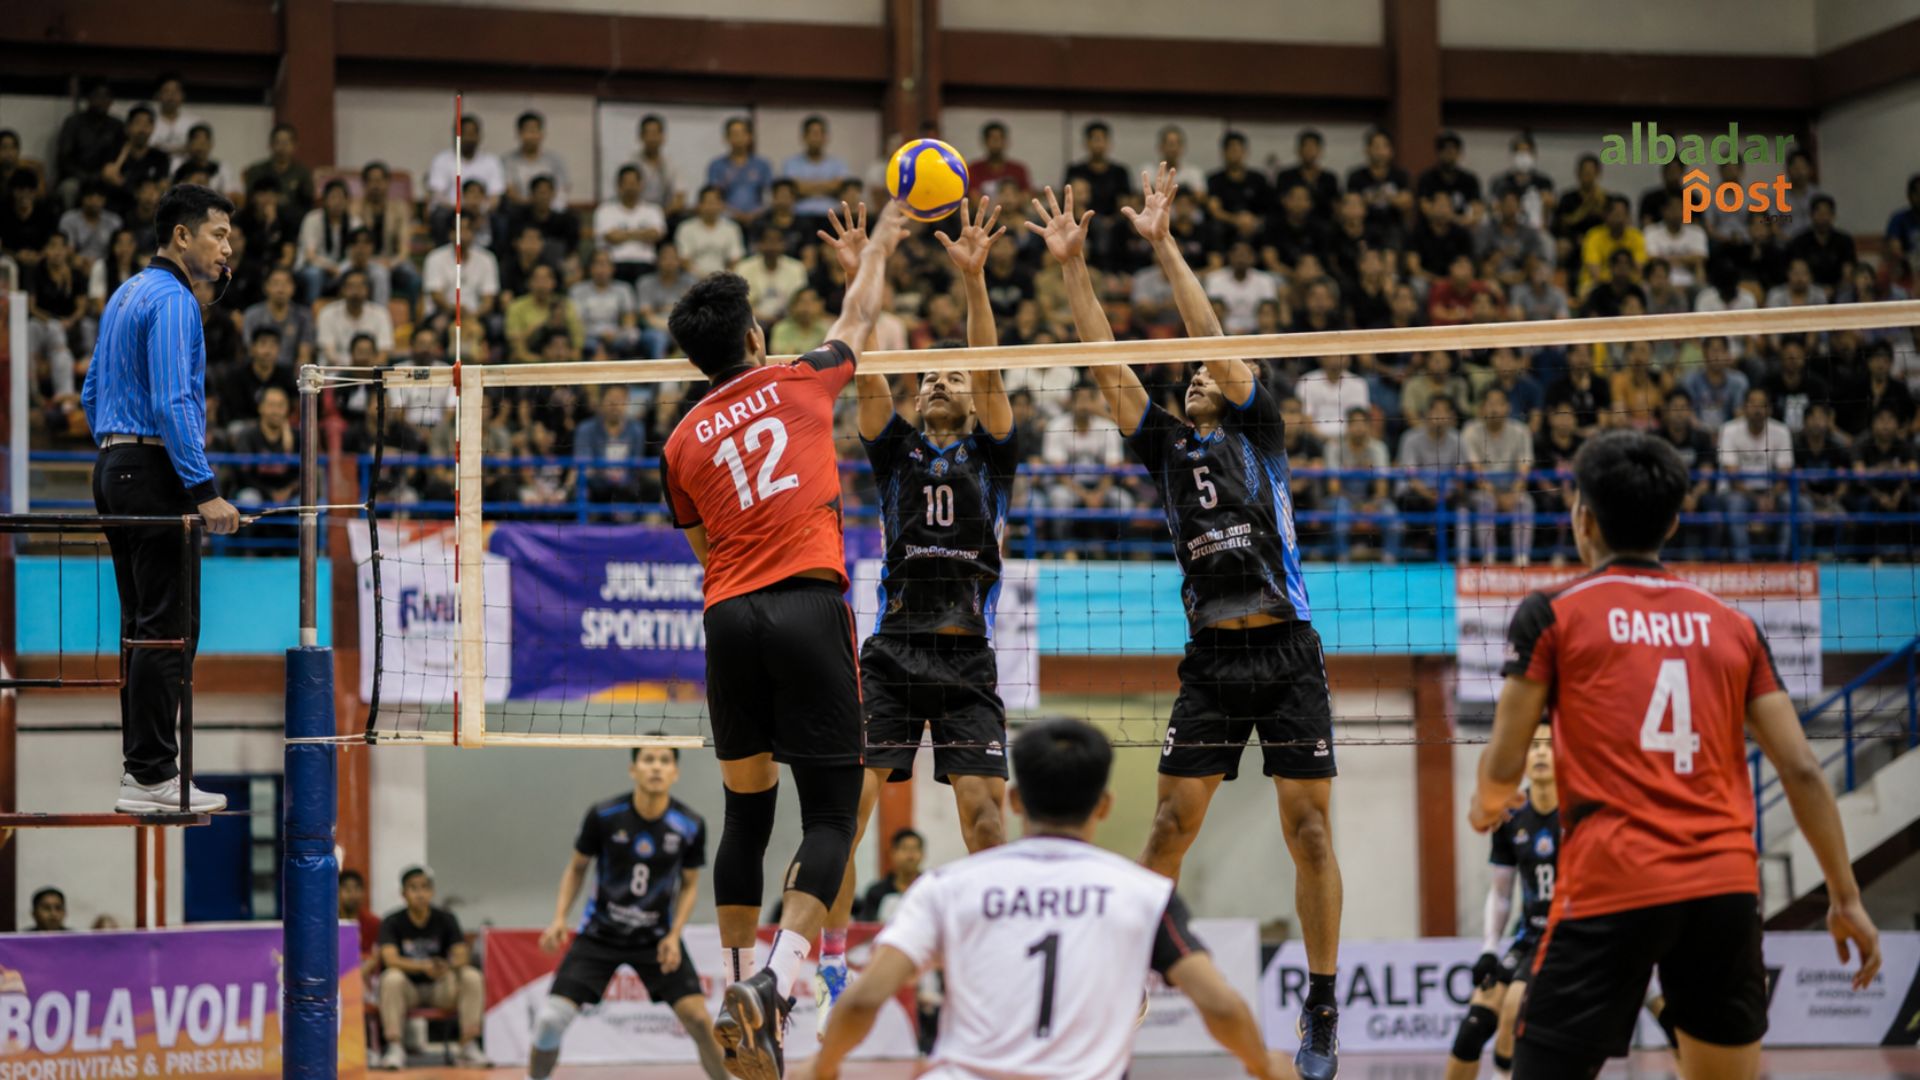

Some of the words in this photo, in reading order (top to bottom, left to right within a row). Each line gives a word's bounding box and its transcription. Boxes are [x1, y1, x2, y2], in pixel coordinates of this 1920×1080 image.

[695, 381, 781, 444] GARUT
[712, 416, 799, 511] 12
[923, 484, 954, 527] 10
[1193, 466, 1218, 509] 5
[1608, 607, 1711, 647] GARUT
[1640, 658, 1700, 774] 4
[1162, 727, 1177, 756] 5
[630, 863, 649, 896] 8
[982, 886, 1112, 919] GARUT
[1026, 932, 1061, 1038] 1
[0, 987, 137, 1056] BOLA
[150, 982, 267, 1048] VOLI
[143, 1052, 158, 1076] &
[165, 1047, 264, 1074] PRESTASI
